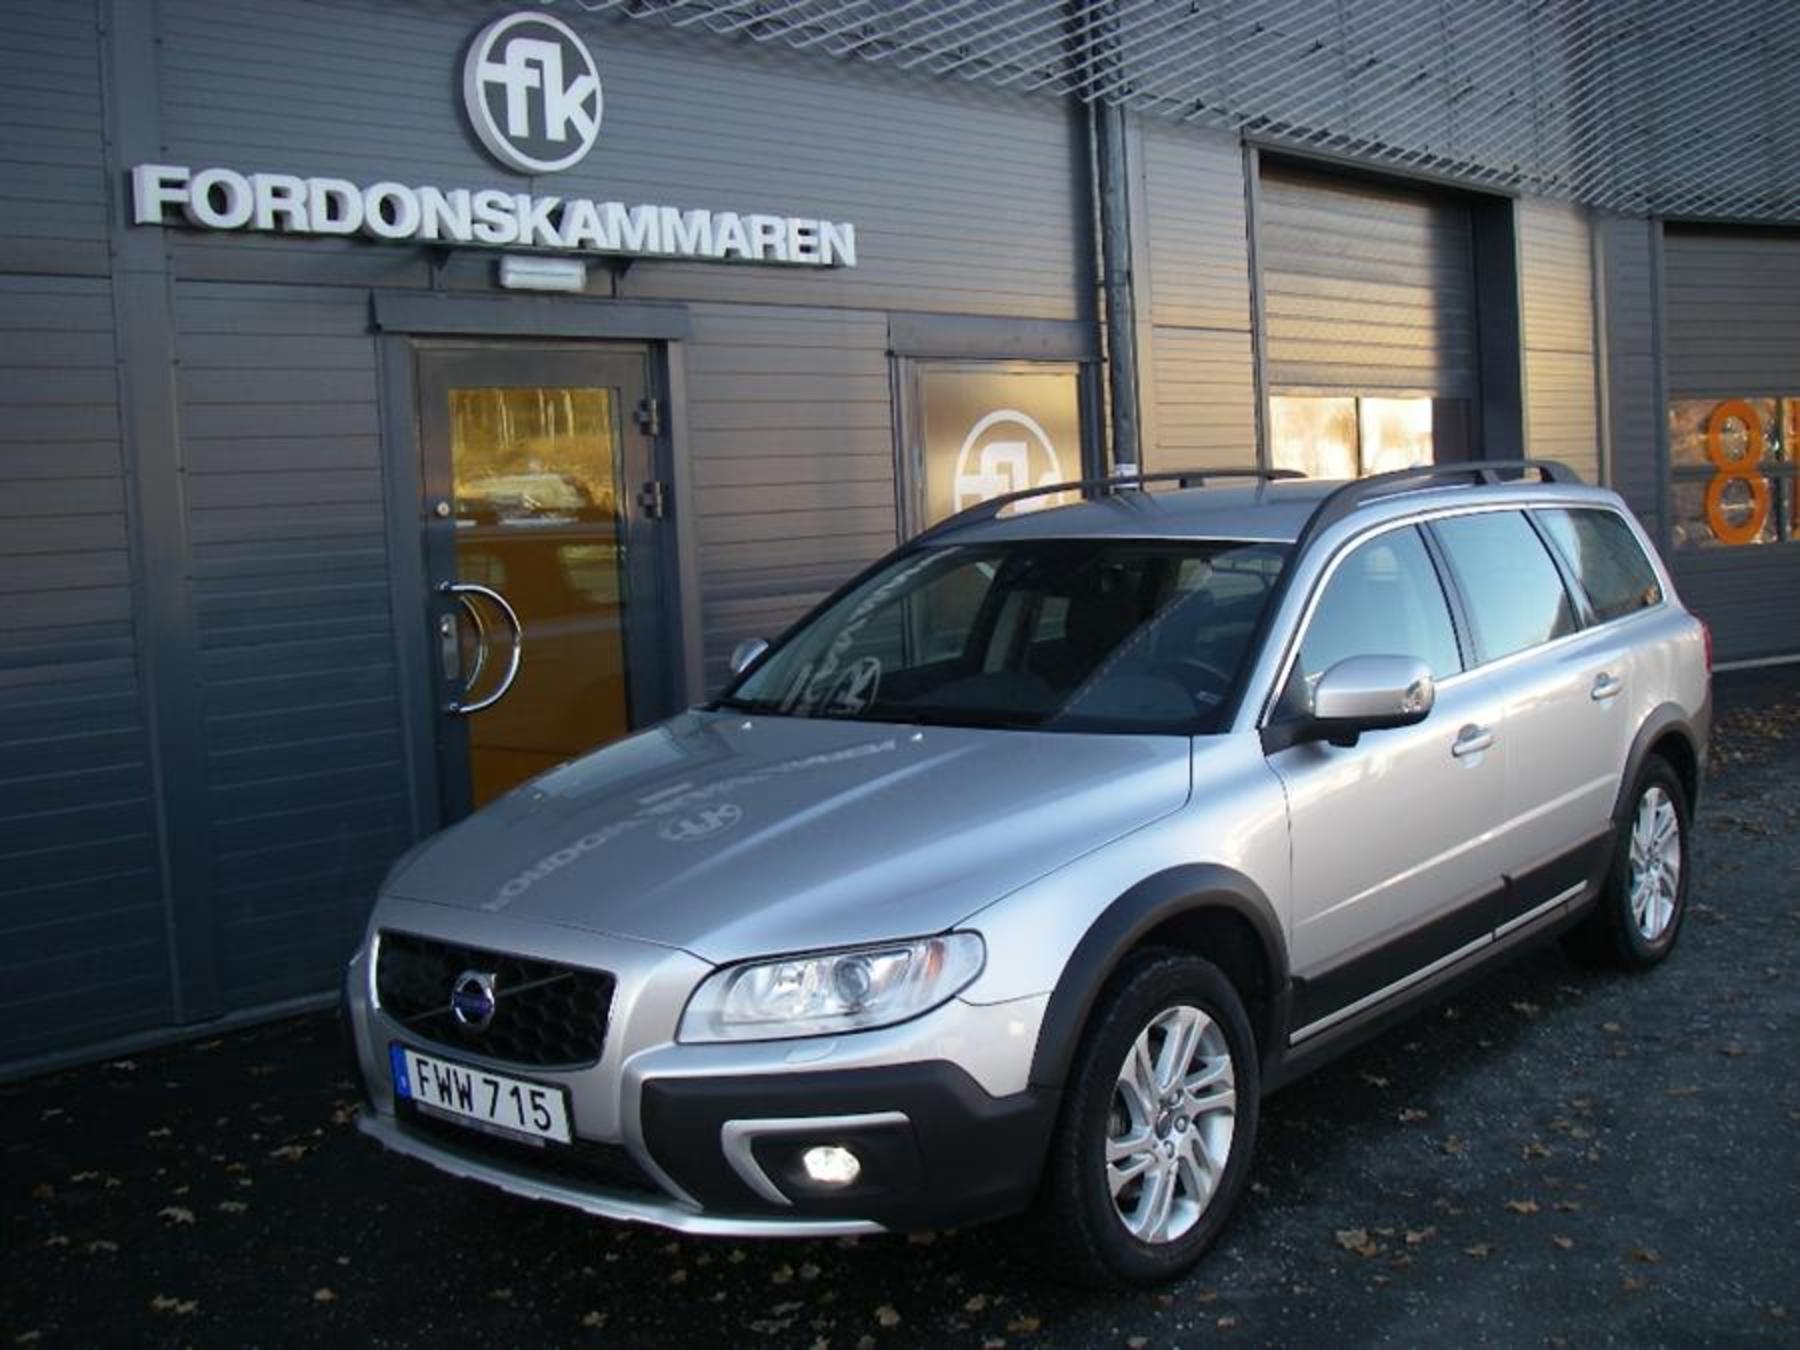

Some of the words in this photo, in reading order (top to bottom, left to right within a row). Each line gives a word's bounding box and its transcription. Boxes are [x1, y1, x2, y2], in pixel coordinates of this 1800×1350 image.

[131, 163, 858, 268] FORDONSKAMMAREN
[1705, 400, 1800, 544] 8
[416, 1058, 474, 1112] FWW
[483, 1078, 552, 1131] 715
